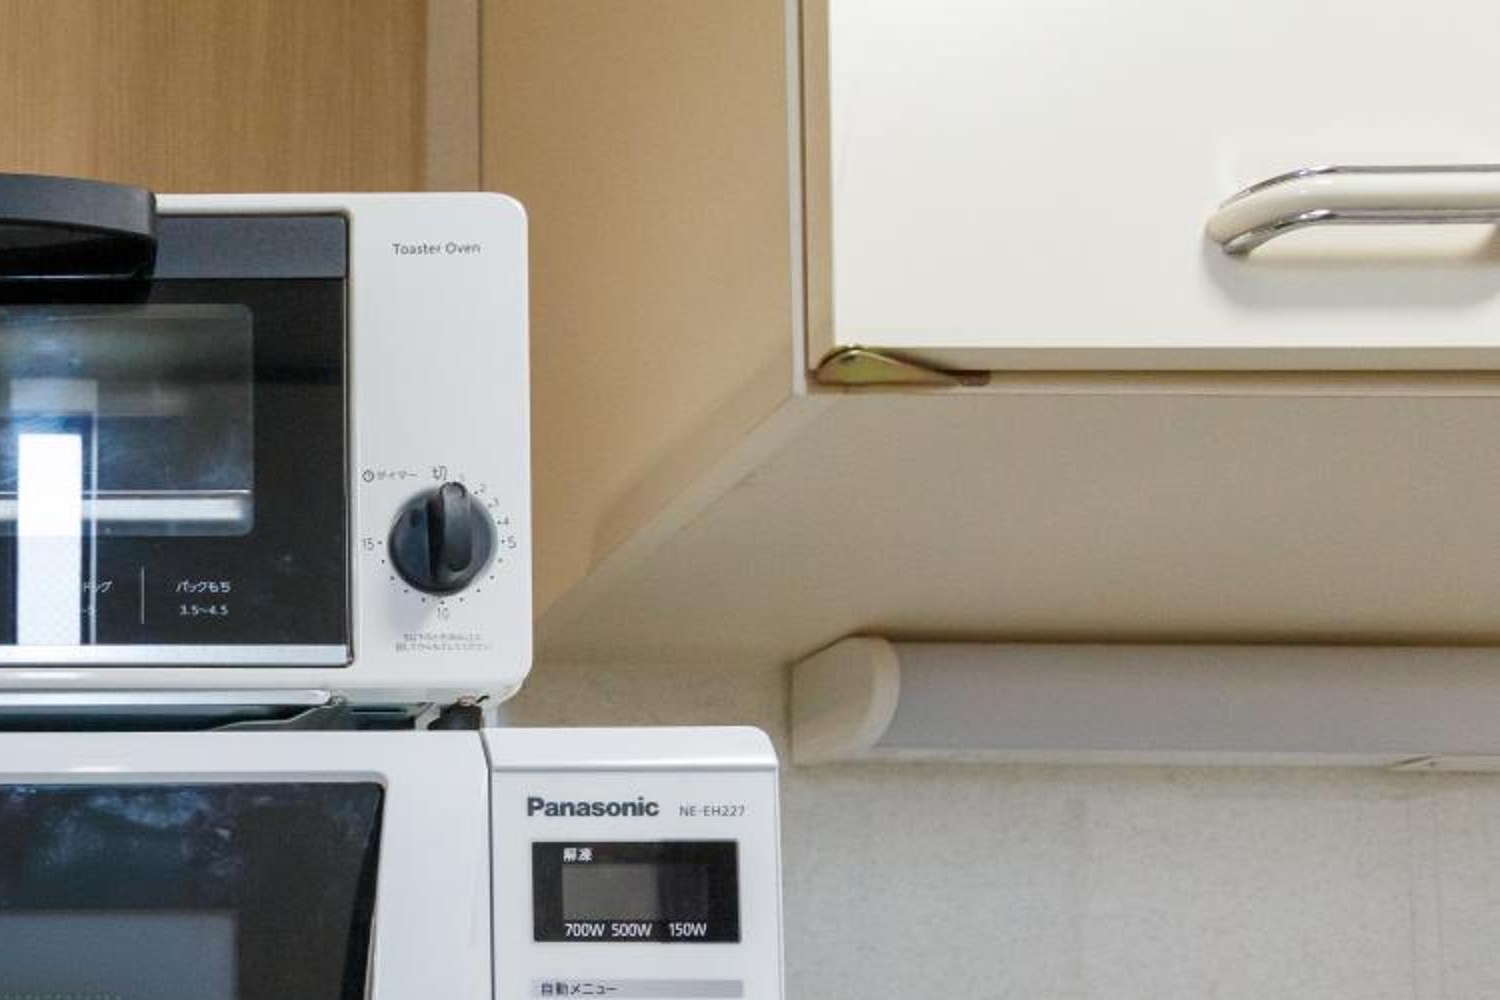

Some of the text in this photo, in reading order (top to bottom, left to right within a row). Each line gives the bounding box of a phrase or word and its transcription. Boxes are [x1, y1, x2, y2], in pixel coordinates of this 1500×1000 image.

[392, 242, 481, 255] Toaster Oven
[432, 465, 448, 481] 切
[507, 536, 517, 549] 5
[175, 580, 231, 593] パックもち
[527, 796, 746, 817] Panasonic NE-EH227
[563, 847, 593, 862] 解凍
[565, 923, 707, 937] 700W 500W 150W
[541, 982, 618, 997] 自動メニュー
